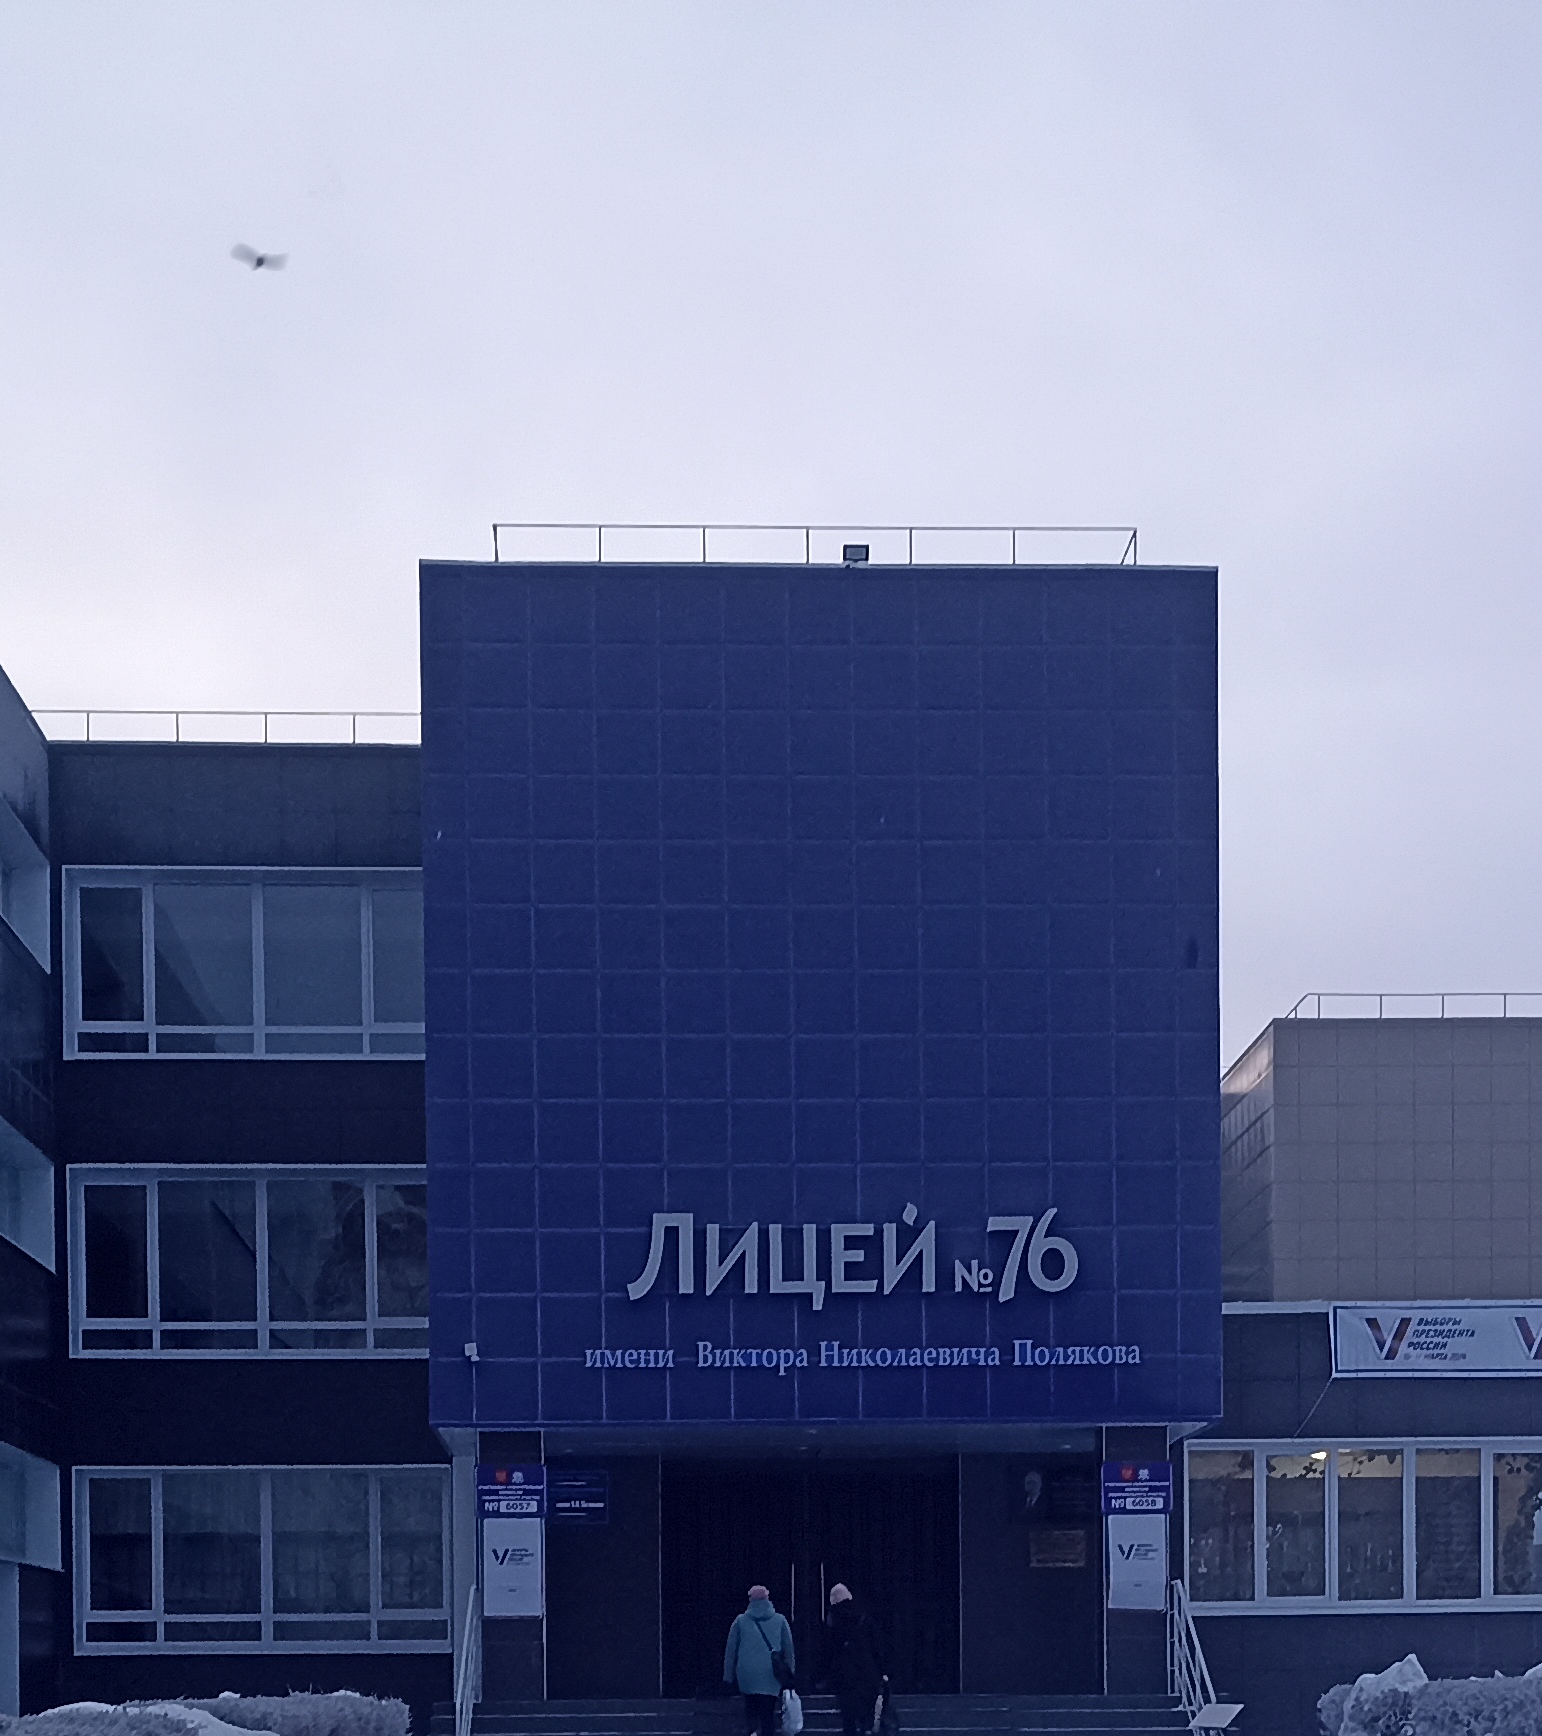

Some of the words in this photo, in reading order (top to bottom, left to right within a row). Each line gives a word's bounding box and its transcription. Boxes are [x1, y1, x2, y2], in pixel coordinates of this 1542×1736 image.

[627, 1202, 935, 1311] ЛИЦЕЙ
[1416, 1317, 1462, 1326] ВЫБОРЫ
[1412, 1329, 1475, 1339] ПРЕЗИДЕНТА
[1407, 1341, 1448, 1351] РОССИИ
[584, 1344, 675, 1370] имени
[696, 1341, 809, 1377] Виктора
[819, 1340, 1001, 1369] Николаевича
[1011, 1339, 1142, 1368] Полякова
